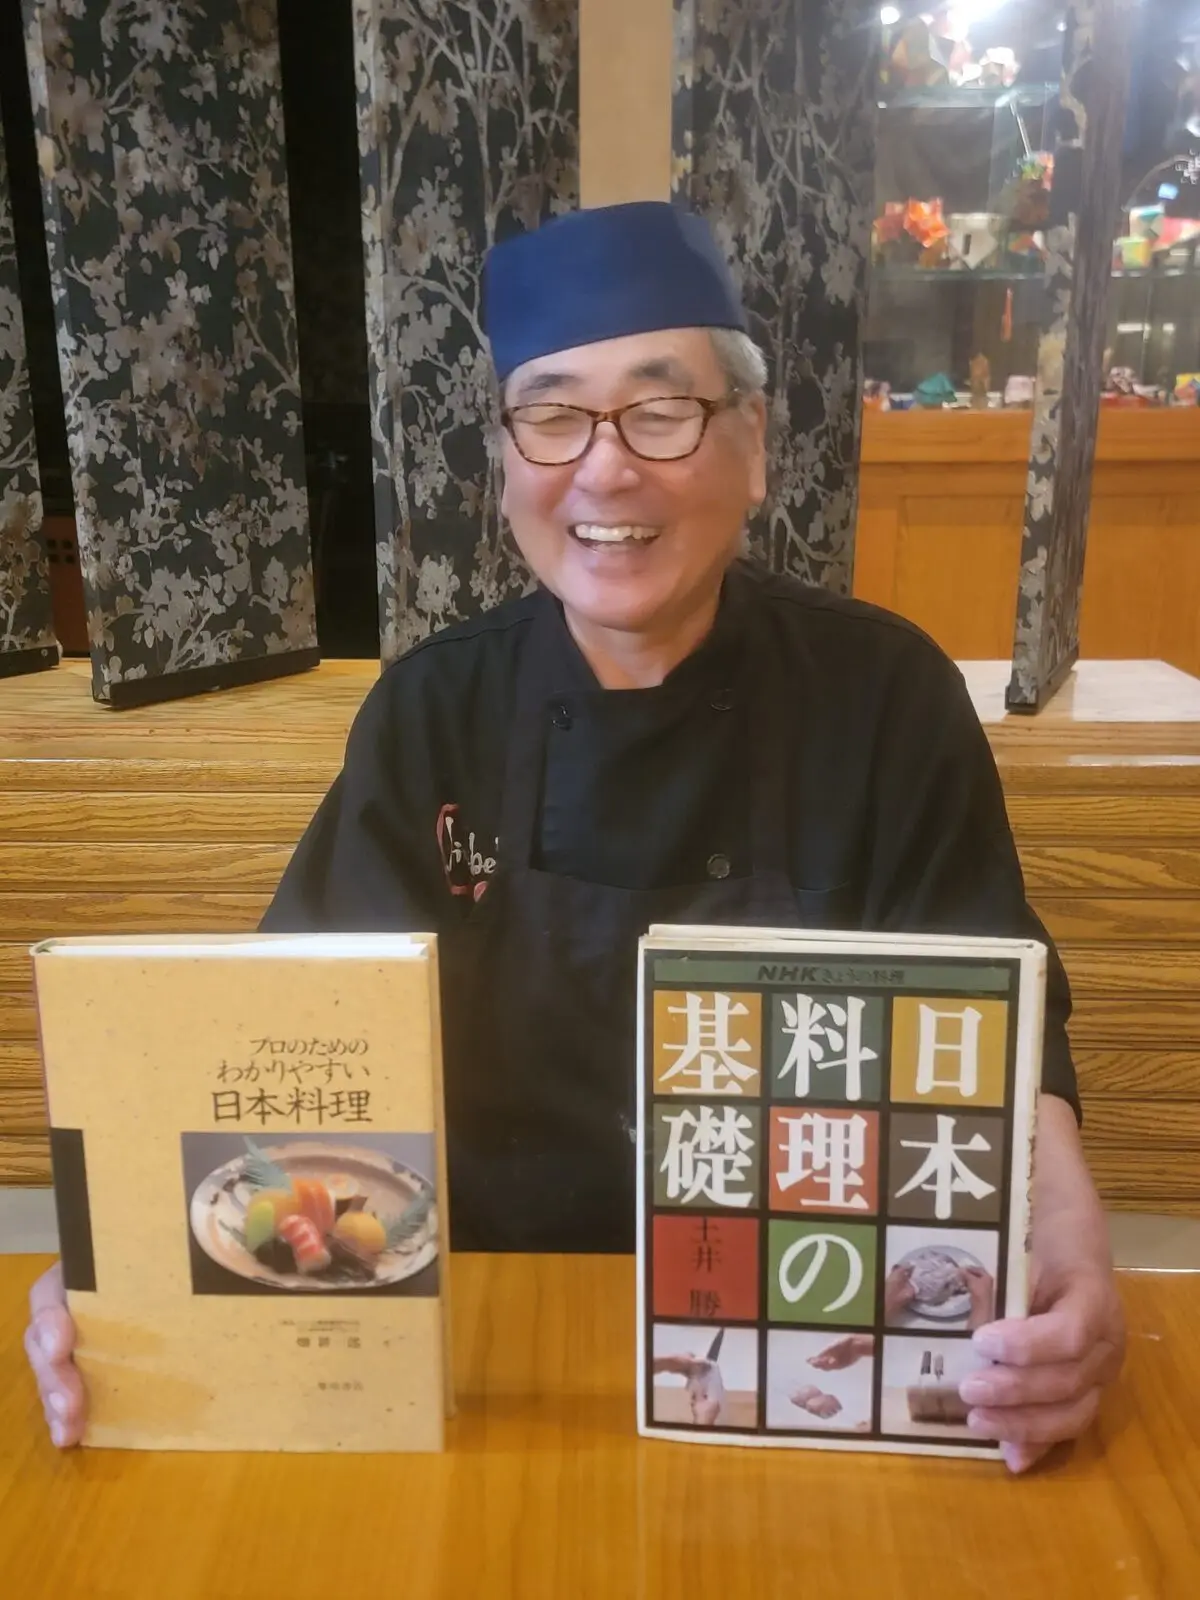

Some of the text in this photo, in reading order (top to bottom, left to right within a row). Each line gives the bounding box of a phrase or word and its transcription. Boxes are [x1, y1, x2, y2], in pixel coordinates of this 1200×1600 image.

[249, 1036, 370, 1057] プロのための
[216, 1057, 371, 1085] わかりやすい
[211, 1085, 374, 1127] 日本料理
[658, 991, 760, 1209] 基礎
[895, 1003, 997, 1220] 日本
